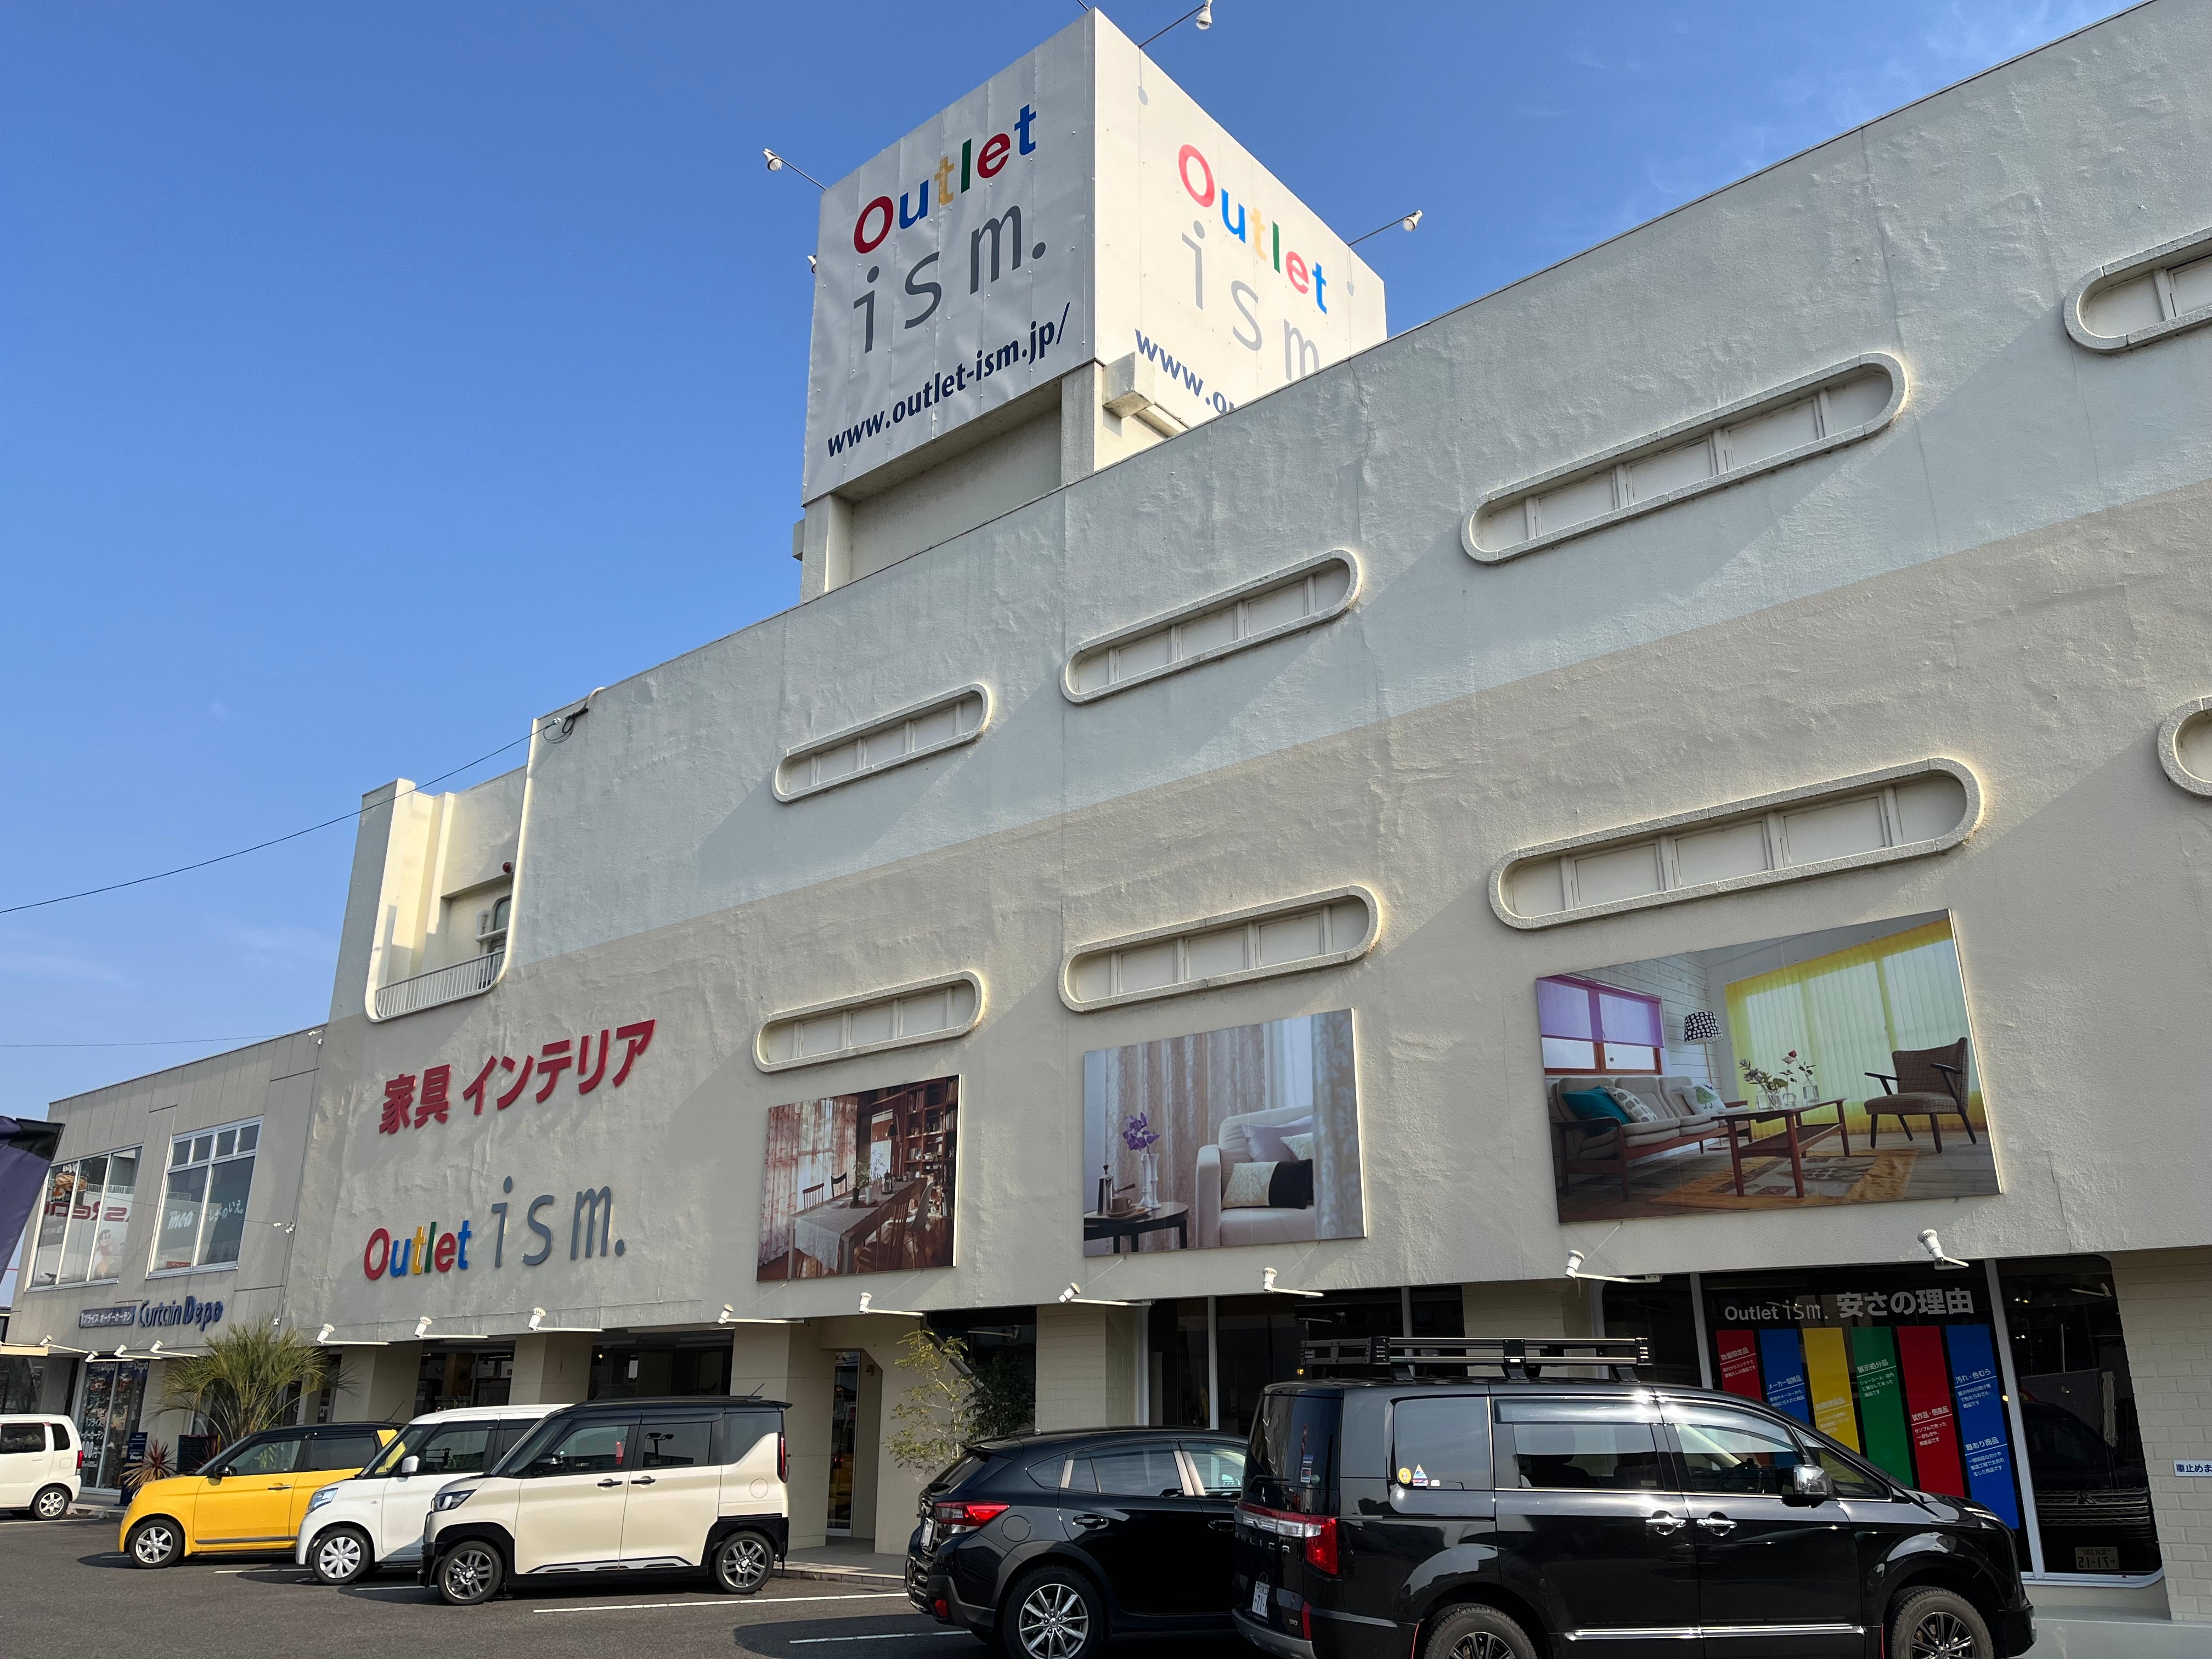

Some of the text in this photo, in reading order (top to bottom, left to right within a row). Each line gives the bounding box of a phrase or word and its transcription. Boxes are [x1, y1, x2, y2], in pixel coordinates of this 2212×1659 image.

[853, 104, 1037, 254] Outlet
[1178, 144, 1328, 315] Outlet
[853, 205, 1046, 353] ism.
[827, 302, 1070, 458] www.outlet-ism.jp/
[379, 1019, 656, 1135] 家具 インテリア
[364, 1176, 625, 1280] Outlet ism.
[139, 1295, 223, 1331] Curtain Depo
[1725, 1305, 1779, 1321] Outlet
[1836, 1287, 1974, 1319] 安さの理由
[1857, 1359, 1889, 1374] 展示処分品
